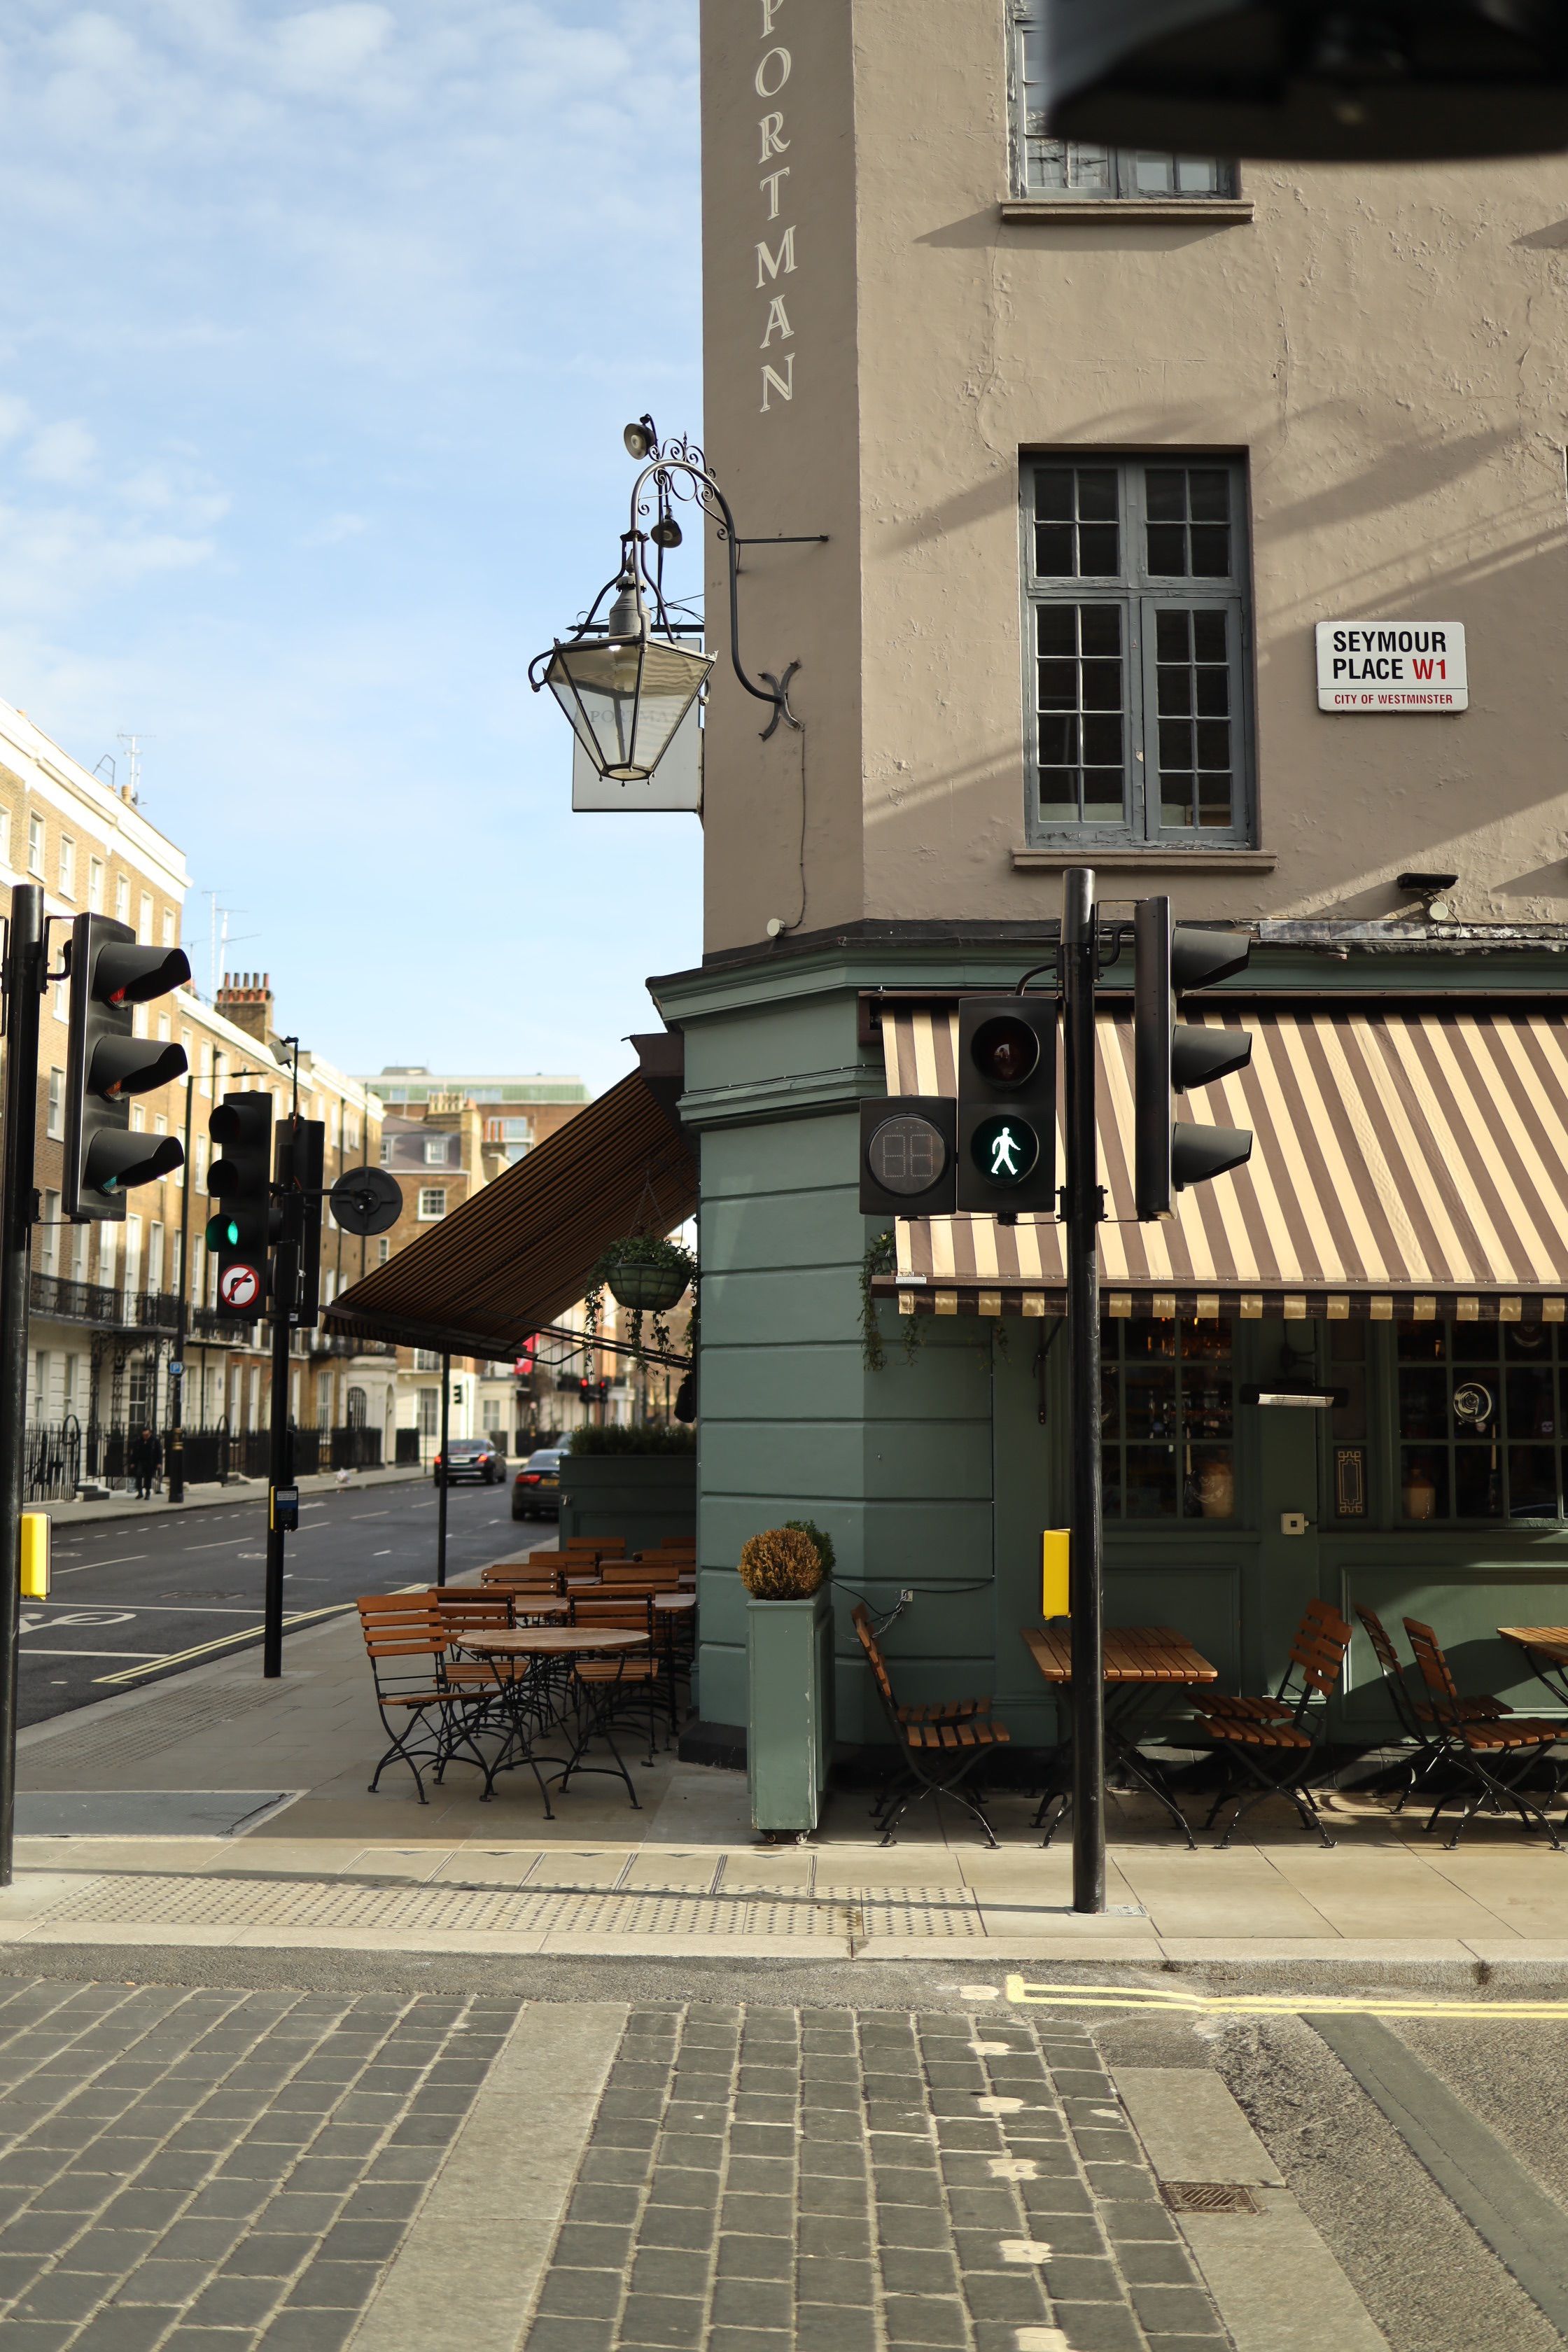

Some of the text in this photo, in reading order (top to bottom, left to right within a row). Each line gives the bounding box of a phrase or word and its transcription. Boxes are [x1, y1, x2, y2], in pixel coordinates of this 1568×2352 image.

[755, 0, 798, 413] PORTMAN
[1334, 631, 1446, 652] SEYMOUR
[1333, 658, 1446, 680] PLACE W1
[1334, 694, 1452, 704] CITY OF WESTMINSTER
